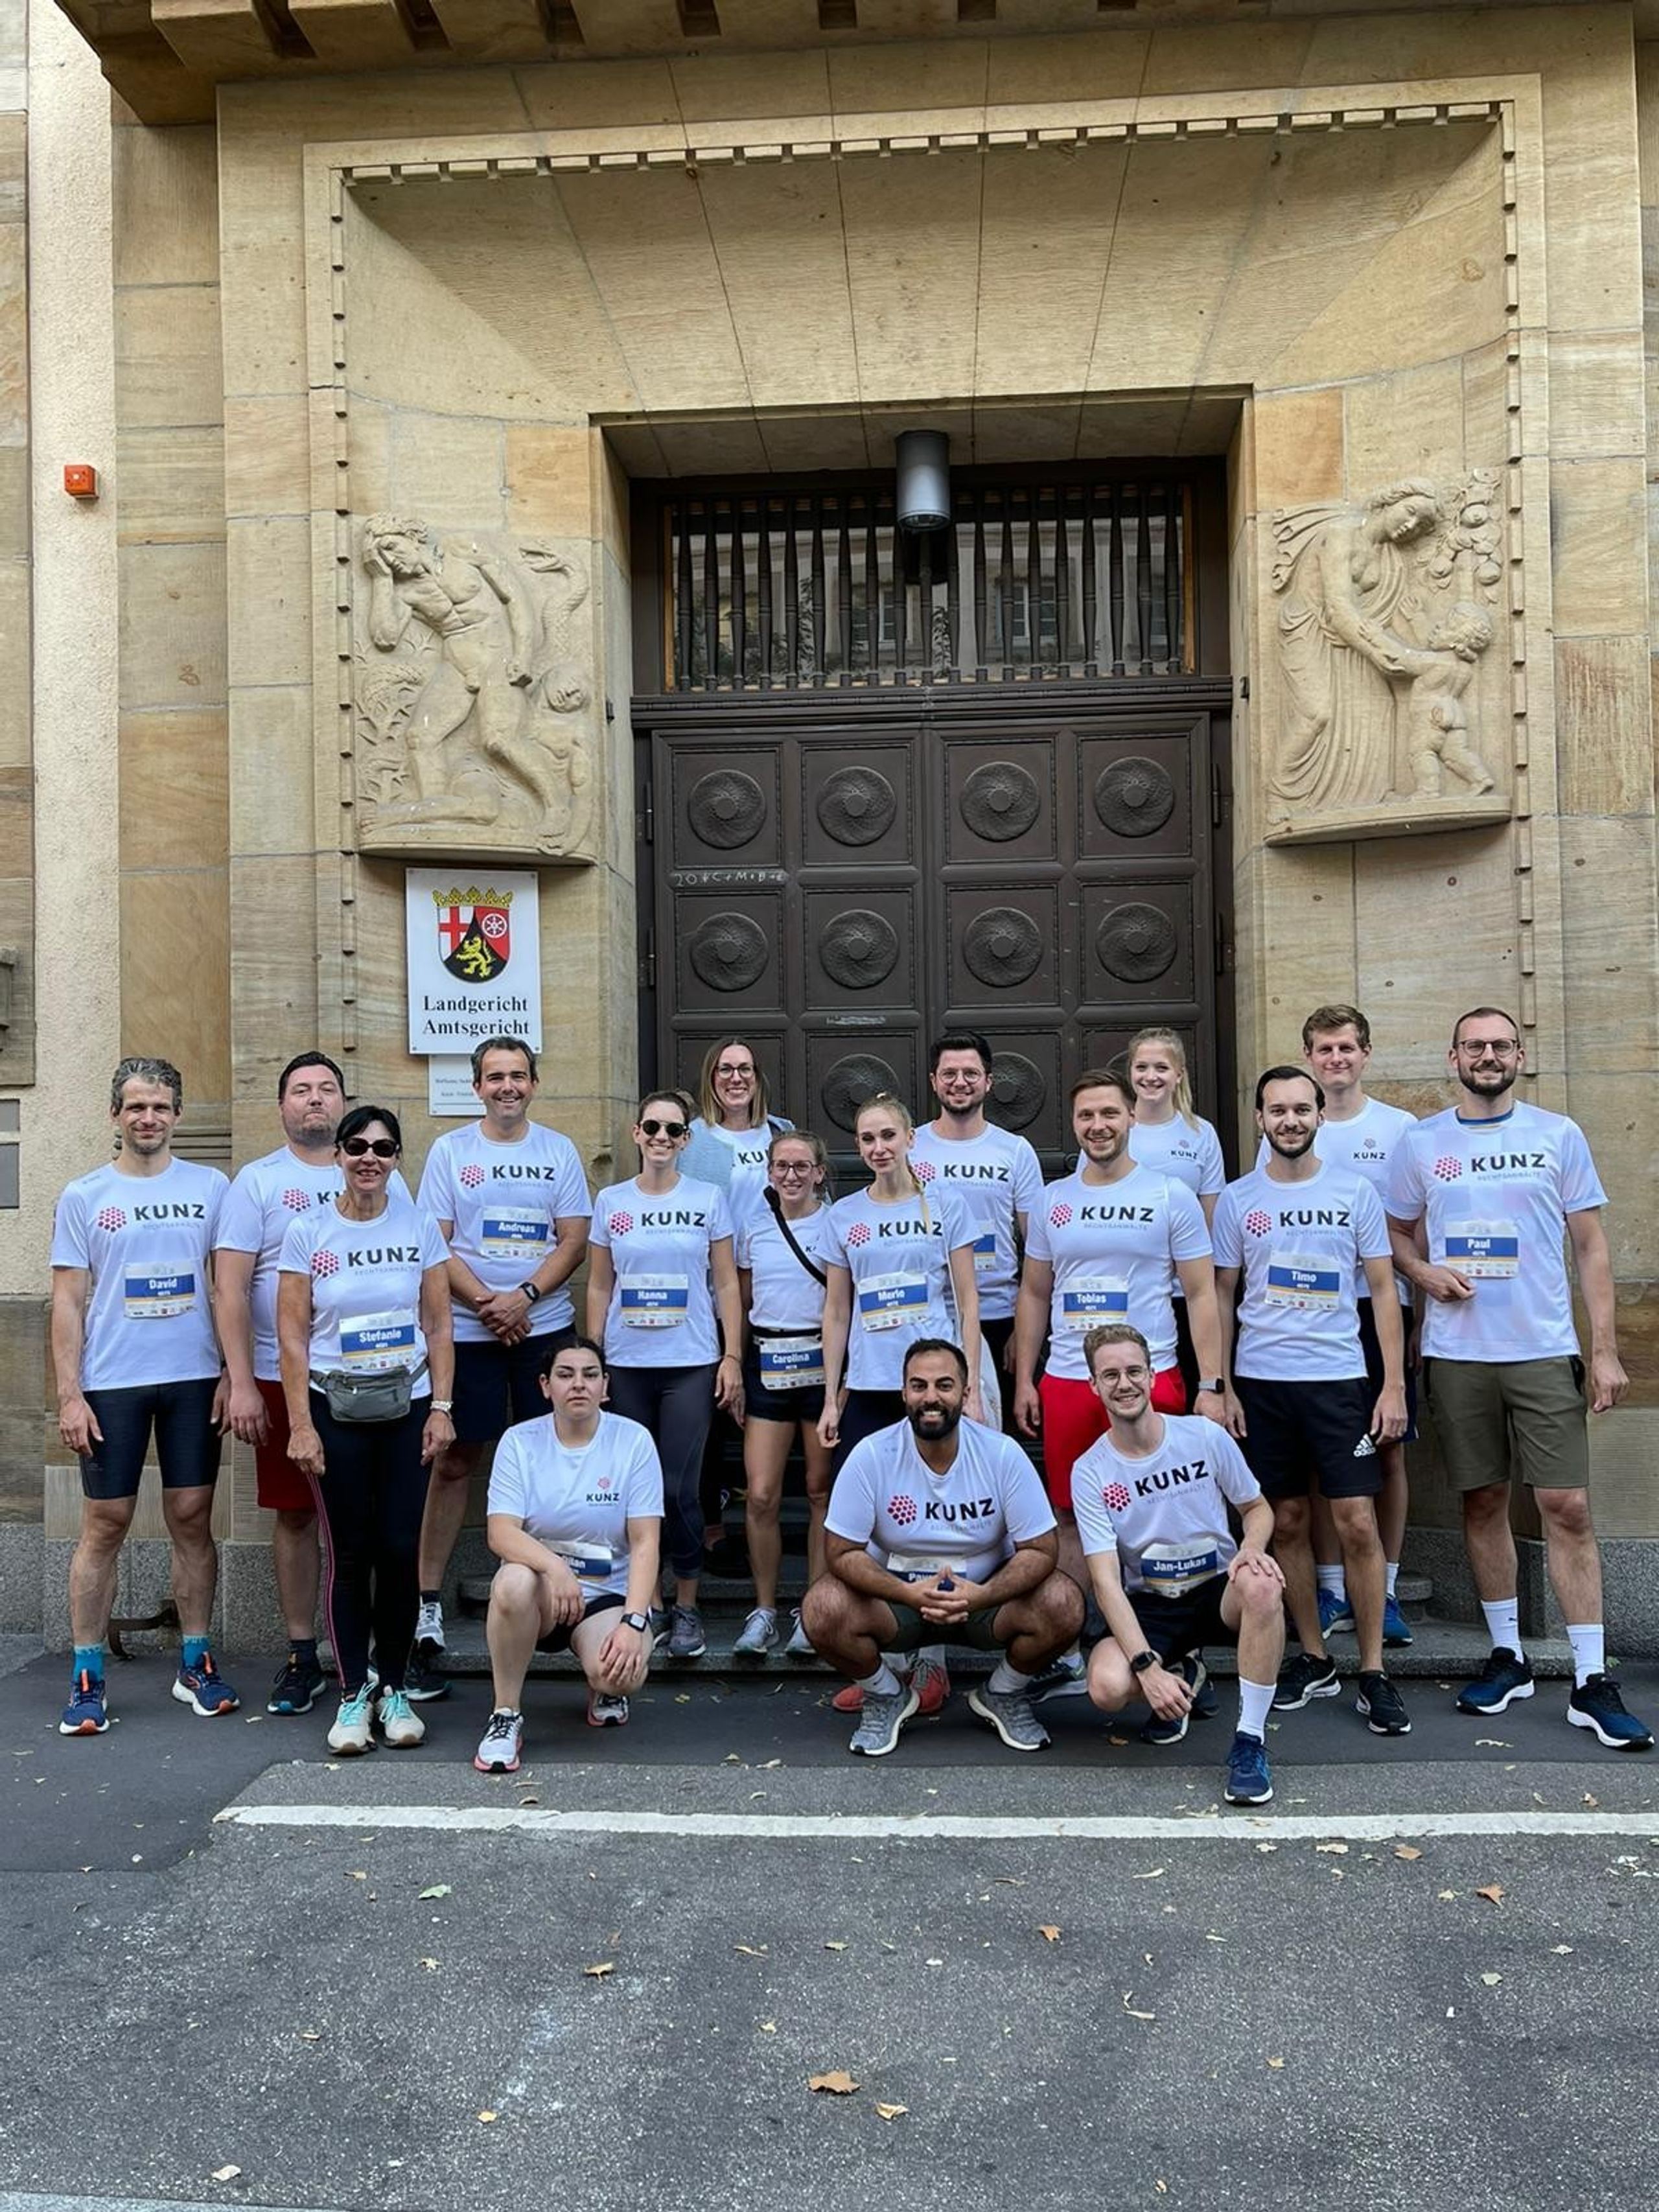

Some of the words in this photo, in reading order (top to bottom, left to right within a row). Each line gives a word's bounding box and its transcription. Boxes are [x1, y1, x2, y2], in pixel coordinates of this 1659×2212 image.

[423, 995, 528, 1015] Landgericht
[423, 1019, 529, 1037] Amtsgericht
[738, 1150, 769, 1165] KU
[1171, 1150, 1198, 1159] KUNZ
[1471, 1153, 1546, 1172] KUNZ
[493, 1165, 555, 1181] KUNZ
[944, 1165, 1009, 1182] KUNZ
[134, 1204, 205, 1220] KUNZ
[642, 1211, 706, 1228] KUNZ
[1081, 1206, 1154, 1222] KUNZ
[1280, 1210, 1350, 1227] KUNZ
[498, 1222, 536, 1233] Andreas
[879, 1221, 942, 1237] KUNZ
[1467, 1239, 1491, 1249] Paul
[348, 1247, 419, 1267] KUNZ
[149, 1277, 177, 1289] David
[1292, 1271, 1317, 1281] Timo
[638, 1290, 667, 1300] Hanna
[1076, 1293, 1107, 1304] Tobias
[359, 1329, 402, 1344] Stefanie
[772, 1353, 809, 1364] Carolina
[1135, 1460, 1209, 1496] KUNZ
[586, 1493, 620, 1502] KUNZ
[925, 1498, 995, 1522] KUNZ
[1154, 1557, 1207, 1571] Jan-Lukas
